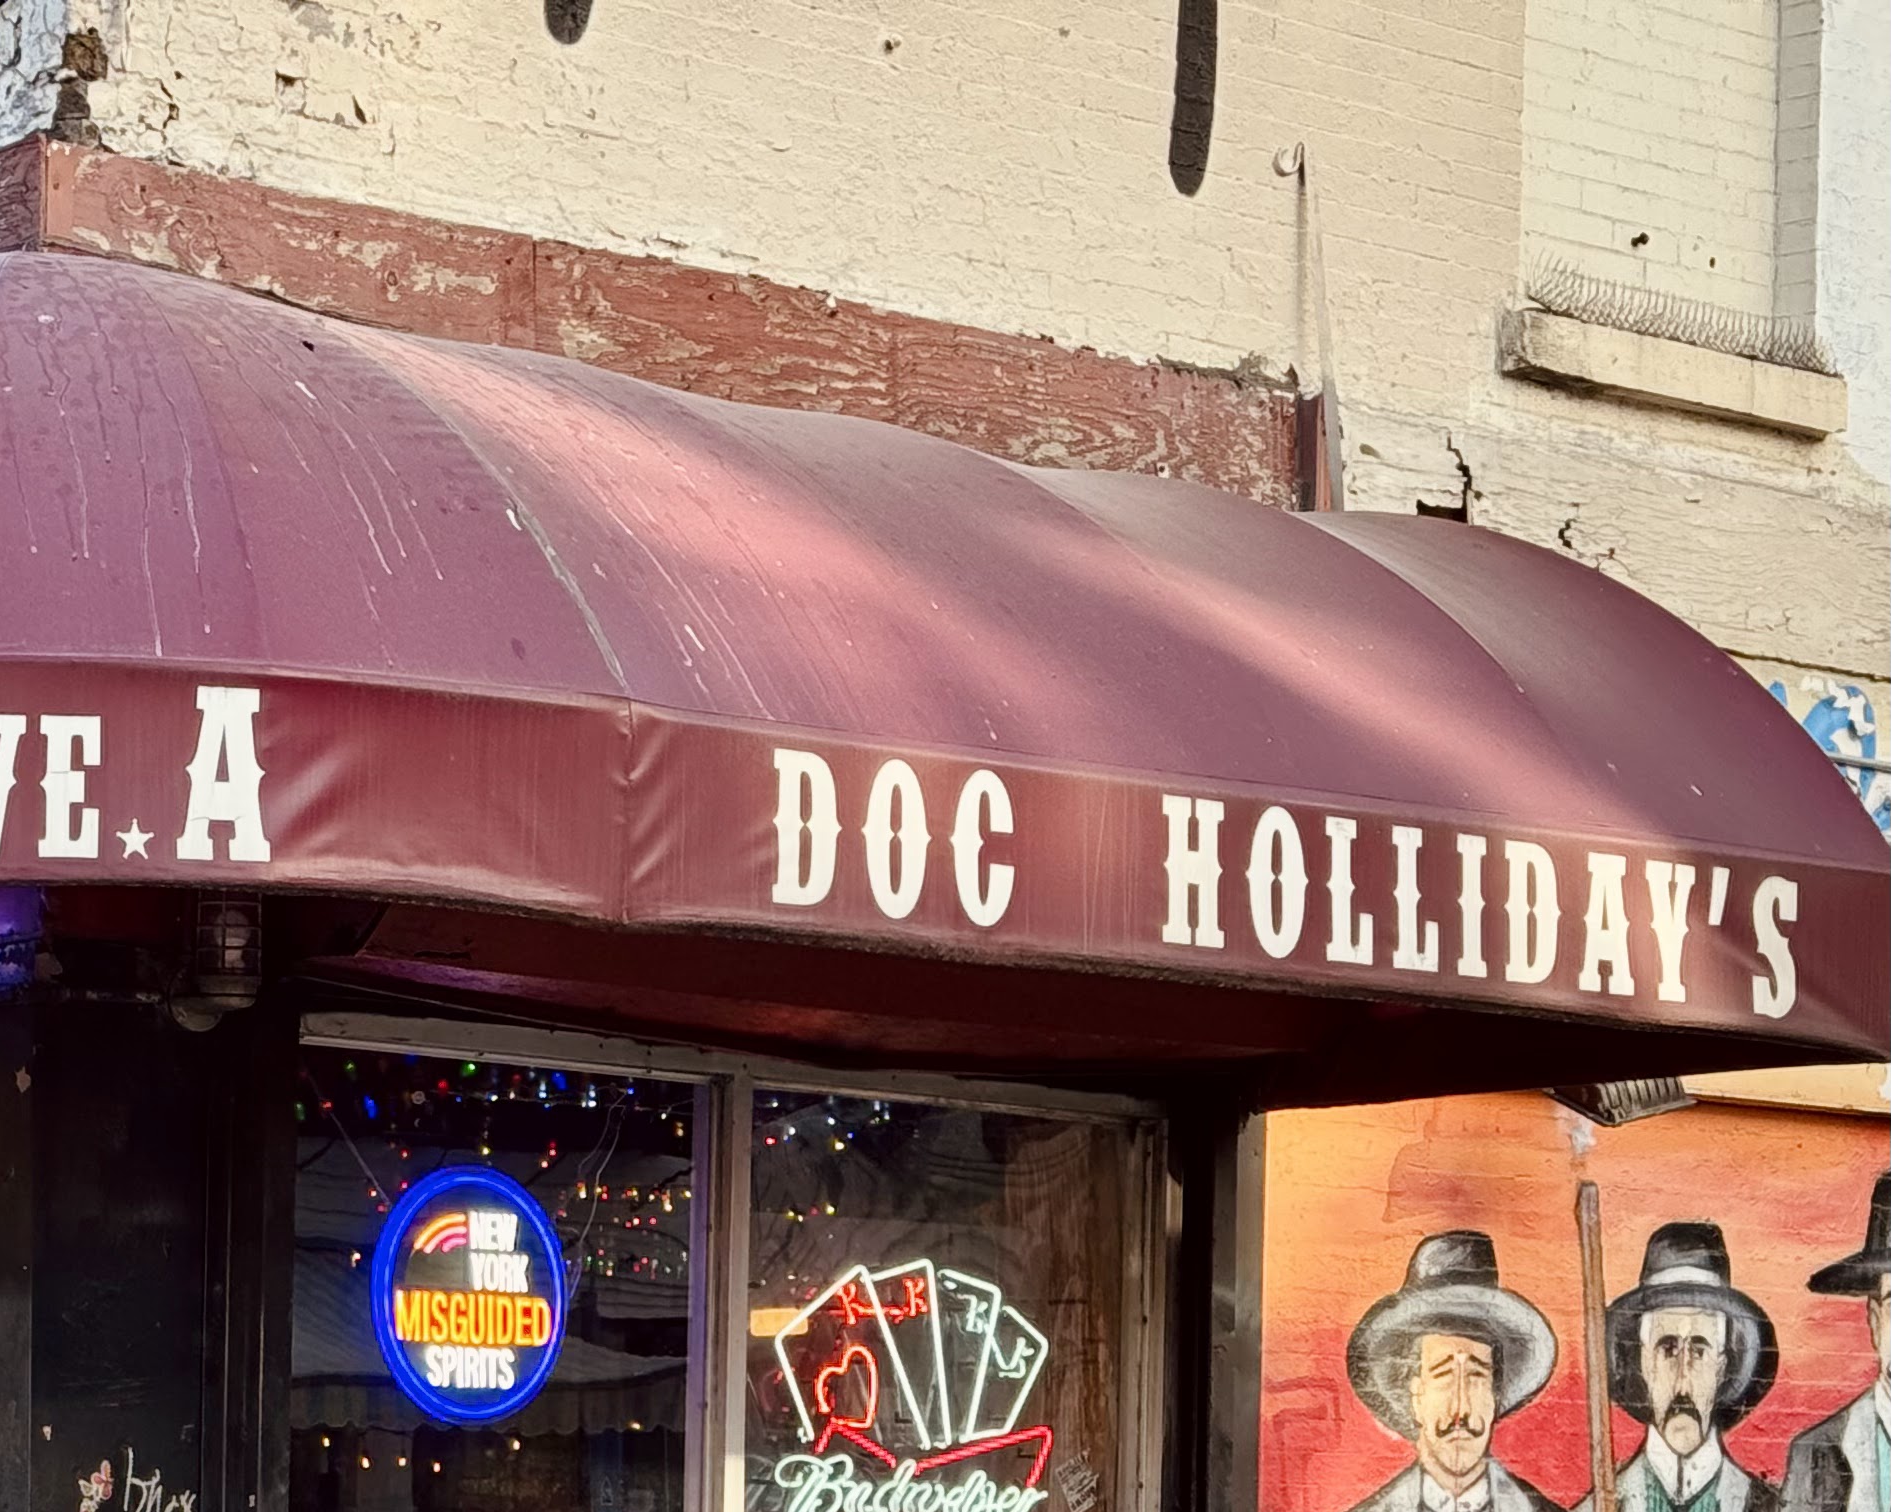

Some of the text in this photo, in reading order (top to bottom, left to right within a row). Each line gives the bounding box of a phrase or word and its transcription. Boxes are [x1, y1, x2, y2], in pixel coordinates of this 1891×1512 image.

[176, 686, 272, 863] A
[771, 747, 1800, 1020] DOC HOLLIDAY'S
[468, 1210, 518, 1252] NEW
[470, 1252, 529, 1293] YORK
[394, 1288, 552, 1348] MISGUIDED
[424, 1344, 516, 1391] SPIRITS
